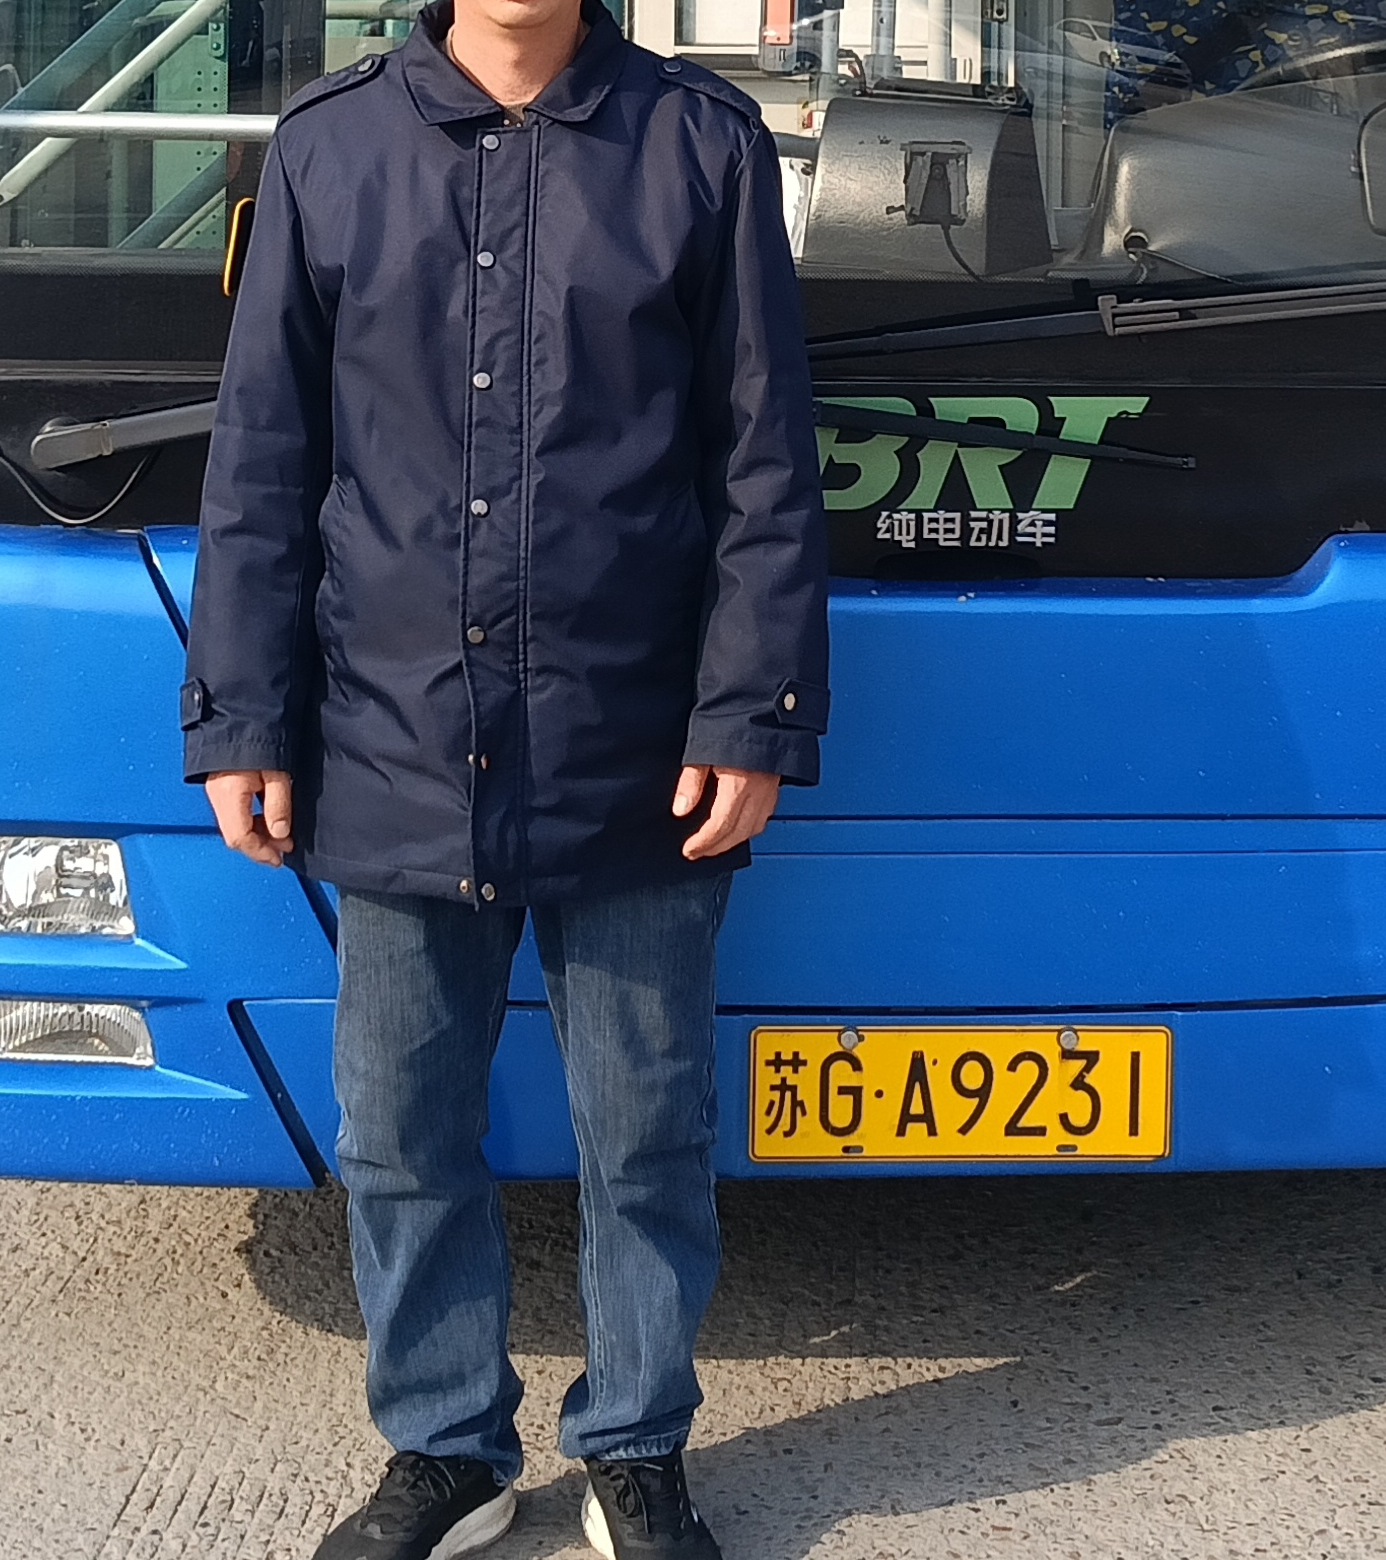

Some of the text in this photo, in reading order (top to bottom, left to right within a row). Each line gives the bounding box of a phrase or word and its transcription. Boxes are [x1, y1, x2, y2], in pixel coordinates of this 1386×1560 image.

[814, 395, 1151, 510] BRT
[876, 511, 1057, 548] 纯电动车
[764, 1049, 1141, 1138] 苏G·A9231
